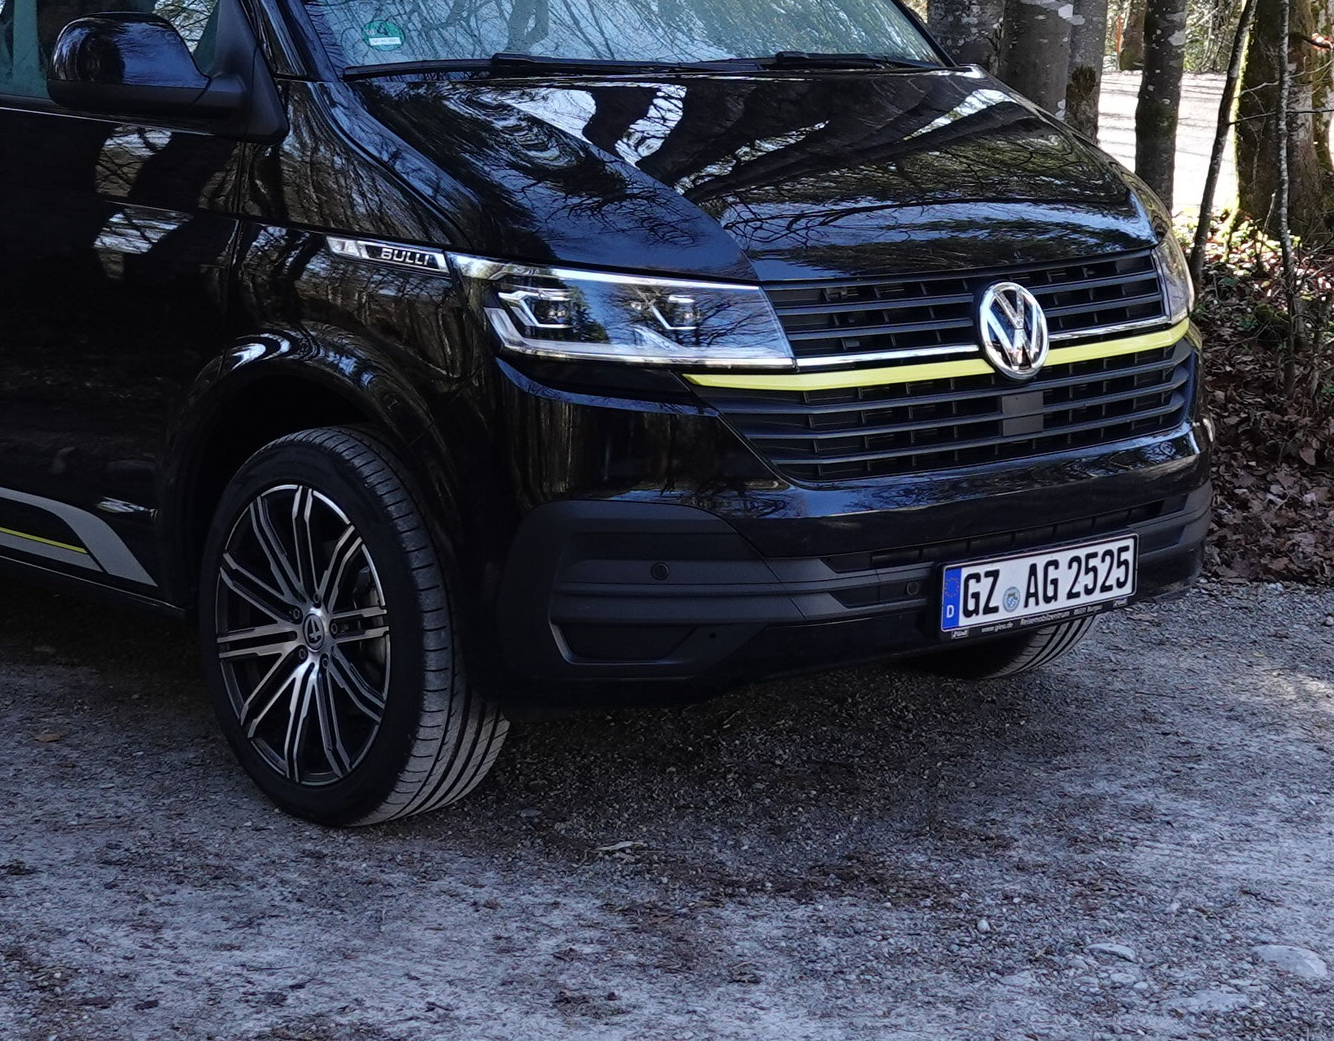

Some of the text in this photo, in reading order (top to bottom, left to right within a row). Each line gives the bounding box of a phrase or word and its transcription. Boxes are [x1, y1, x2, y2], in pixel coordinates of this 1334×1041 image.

[381, 248, 430, 265] BULLI
[962, 545, 1130, 618] GZ AG 2525
[946, 604, 955, 619] D
